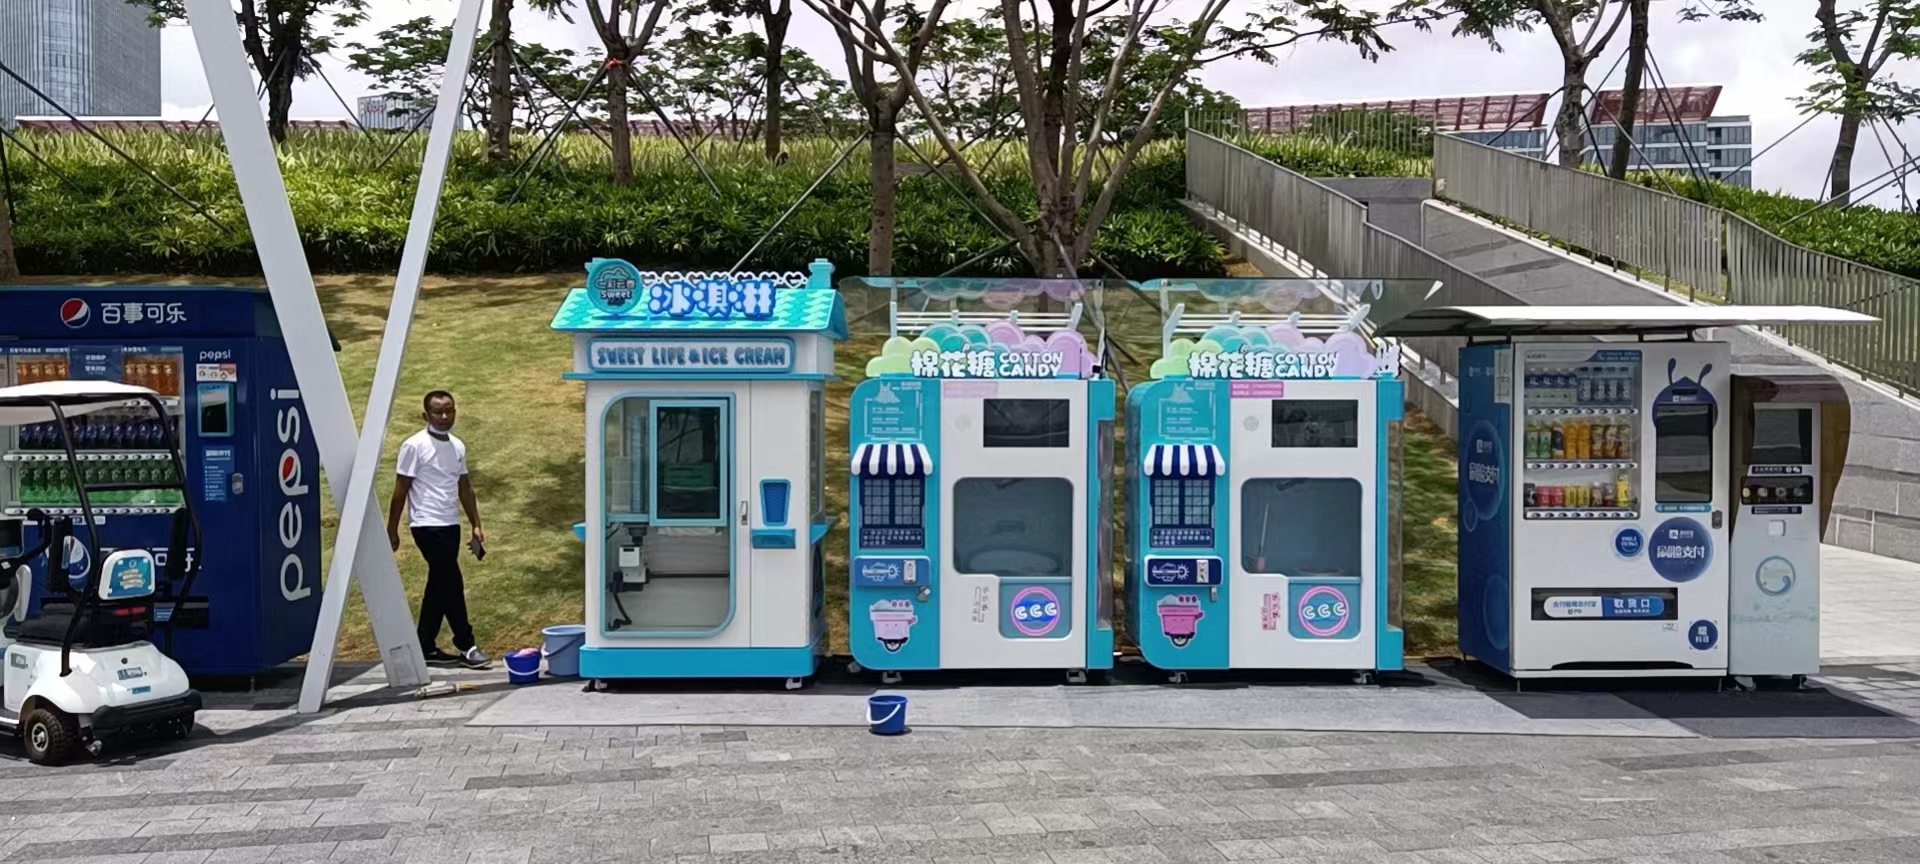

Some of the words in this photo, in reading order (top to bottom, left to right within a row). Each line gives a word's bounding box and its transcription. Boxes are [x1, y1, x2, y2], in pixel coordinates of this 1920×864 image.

[600, 290, 631, 299] Sweet
[649, 280, 774, 317] 冰淇淋
[101, 302, 187, 324] 百事可乐
[199, 349, 231, 361] pepsi
[597, 347, 644, 366] SWEET
[651, 347, 686, 366] LIFE
[702, 347, 728, 365] ICE
[734, 347, 785, 366] CREAM
[911, 346, 996, 377] 棉花糖
[999, 351, 1064, 364] COTTON
[1275, 352, 1340, 365] COTTON
[1189, 347, 1273, 378] 棉花糖
[999, 364, 1061, 377] CANDY
[1275, 364, 1335, 378] CANDY
[270, 388, 311, 601] pepsi
[1656, 545, 1705, 559] 刷脸支付
[1613, 598, 1650, 609] 取货口
